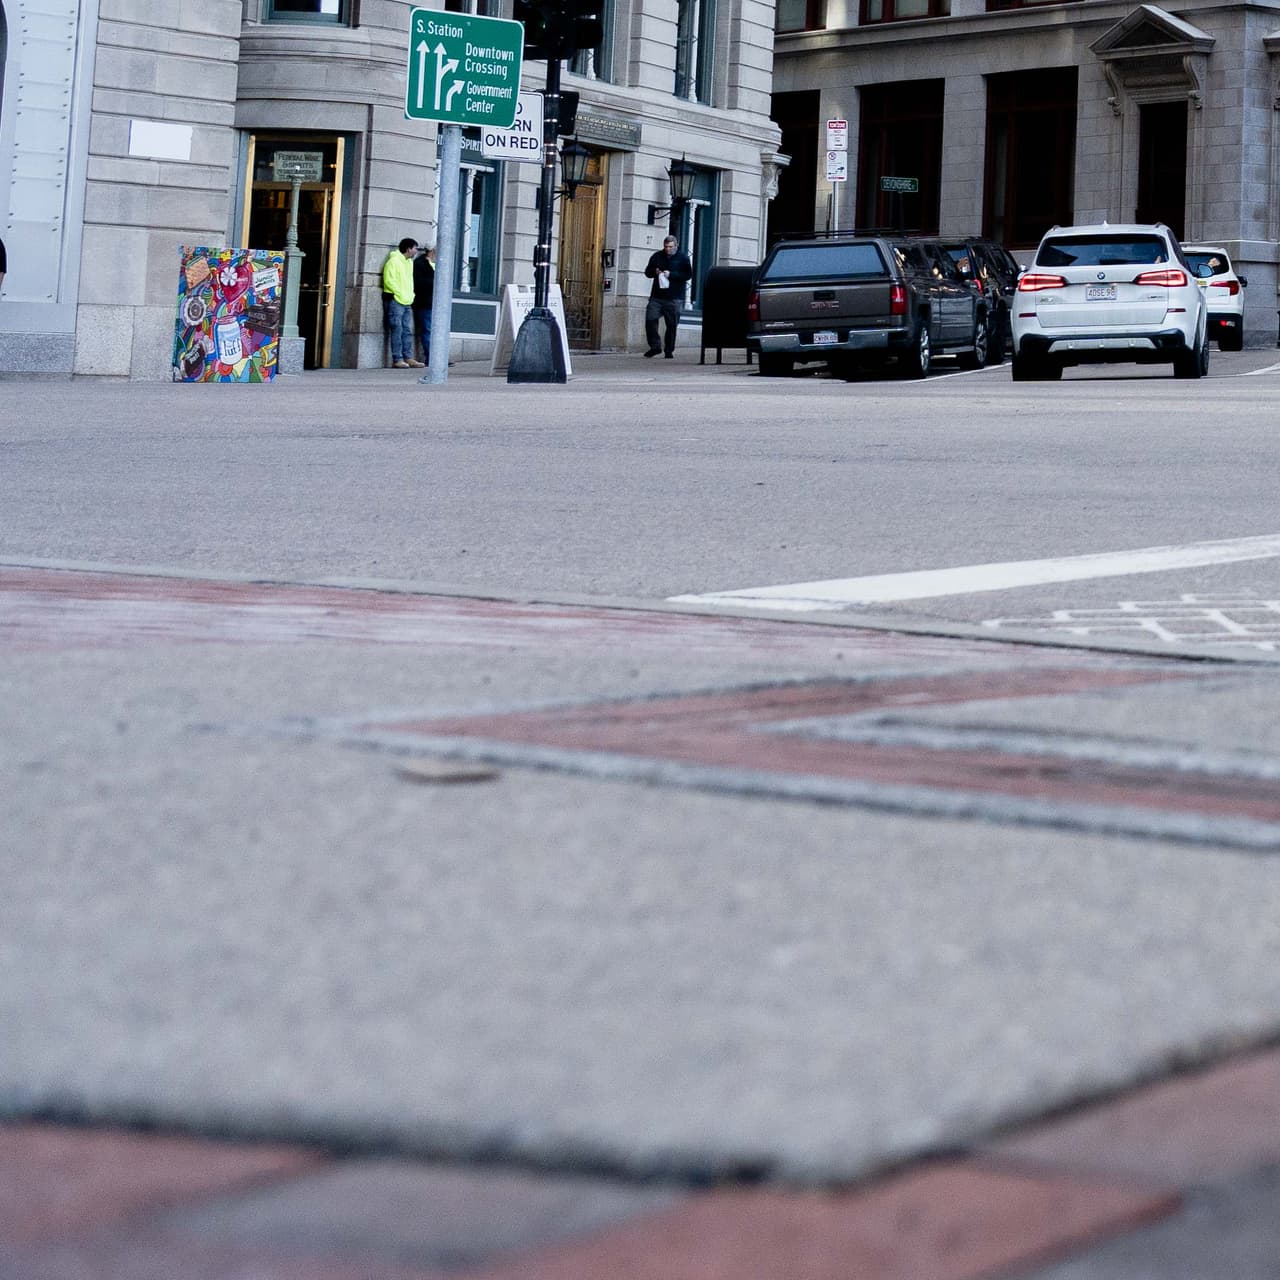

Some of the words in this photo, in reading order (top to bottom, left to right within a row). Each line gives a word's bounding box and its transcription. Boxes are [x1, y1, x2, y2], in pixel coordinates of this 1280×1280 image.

[417, 19, 426, 34] S.
[427, 20, 463, 38] Station
[465, 42, 515, 62] Downtown
[465, 58, 508, 81] Crossing
[466, 80, 513, 99] Government
[465, 97, 495, 114] Center
[515, 119, 532, 132] RN
[485, 134, 506, 147] ON
[510, 136, 539, 150] RED
